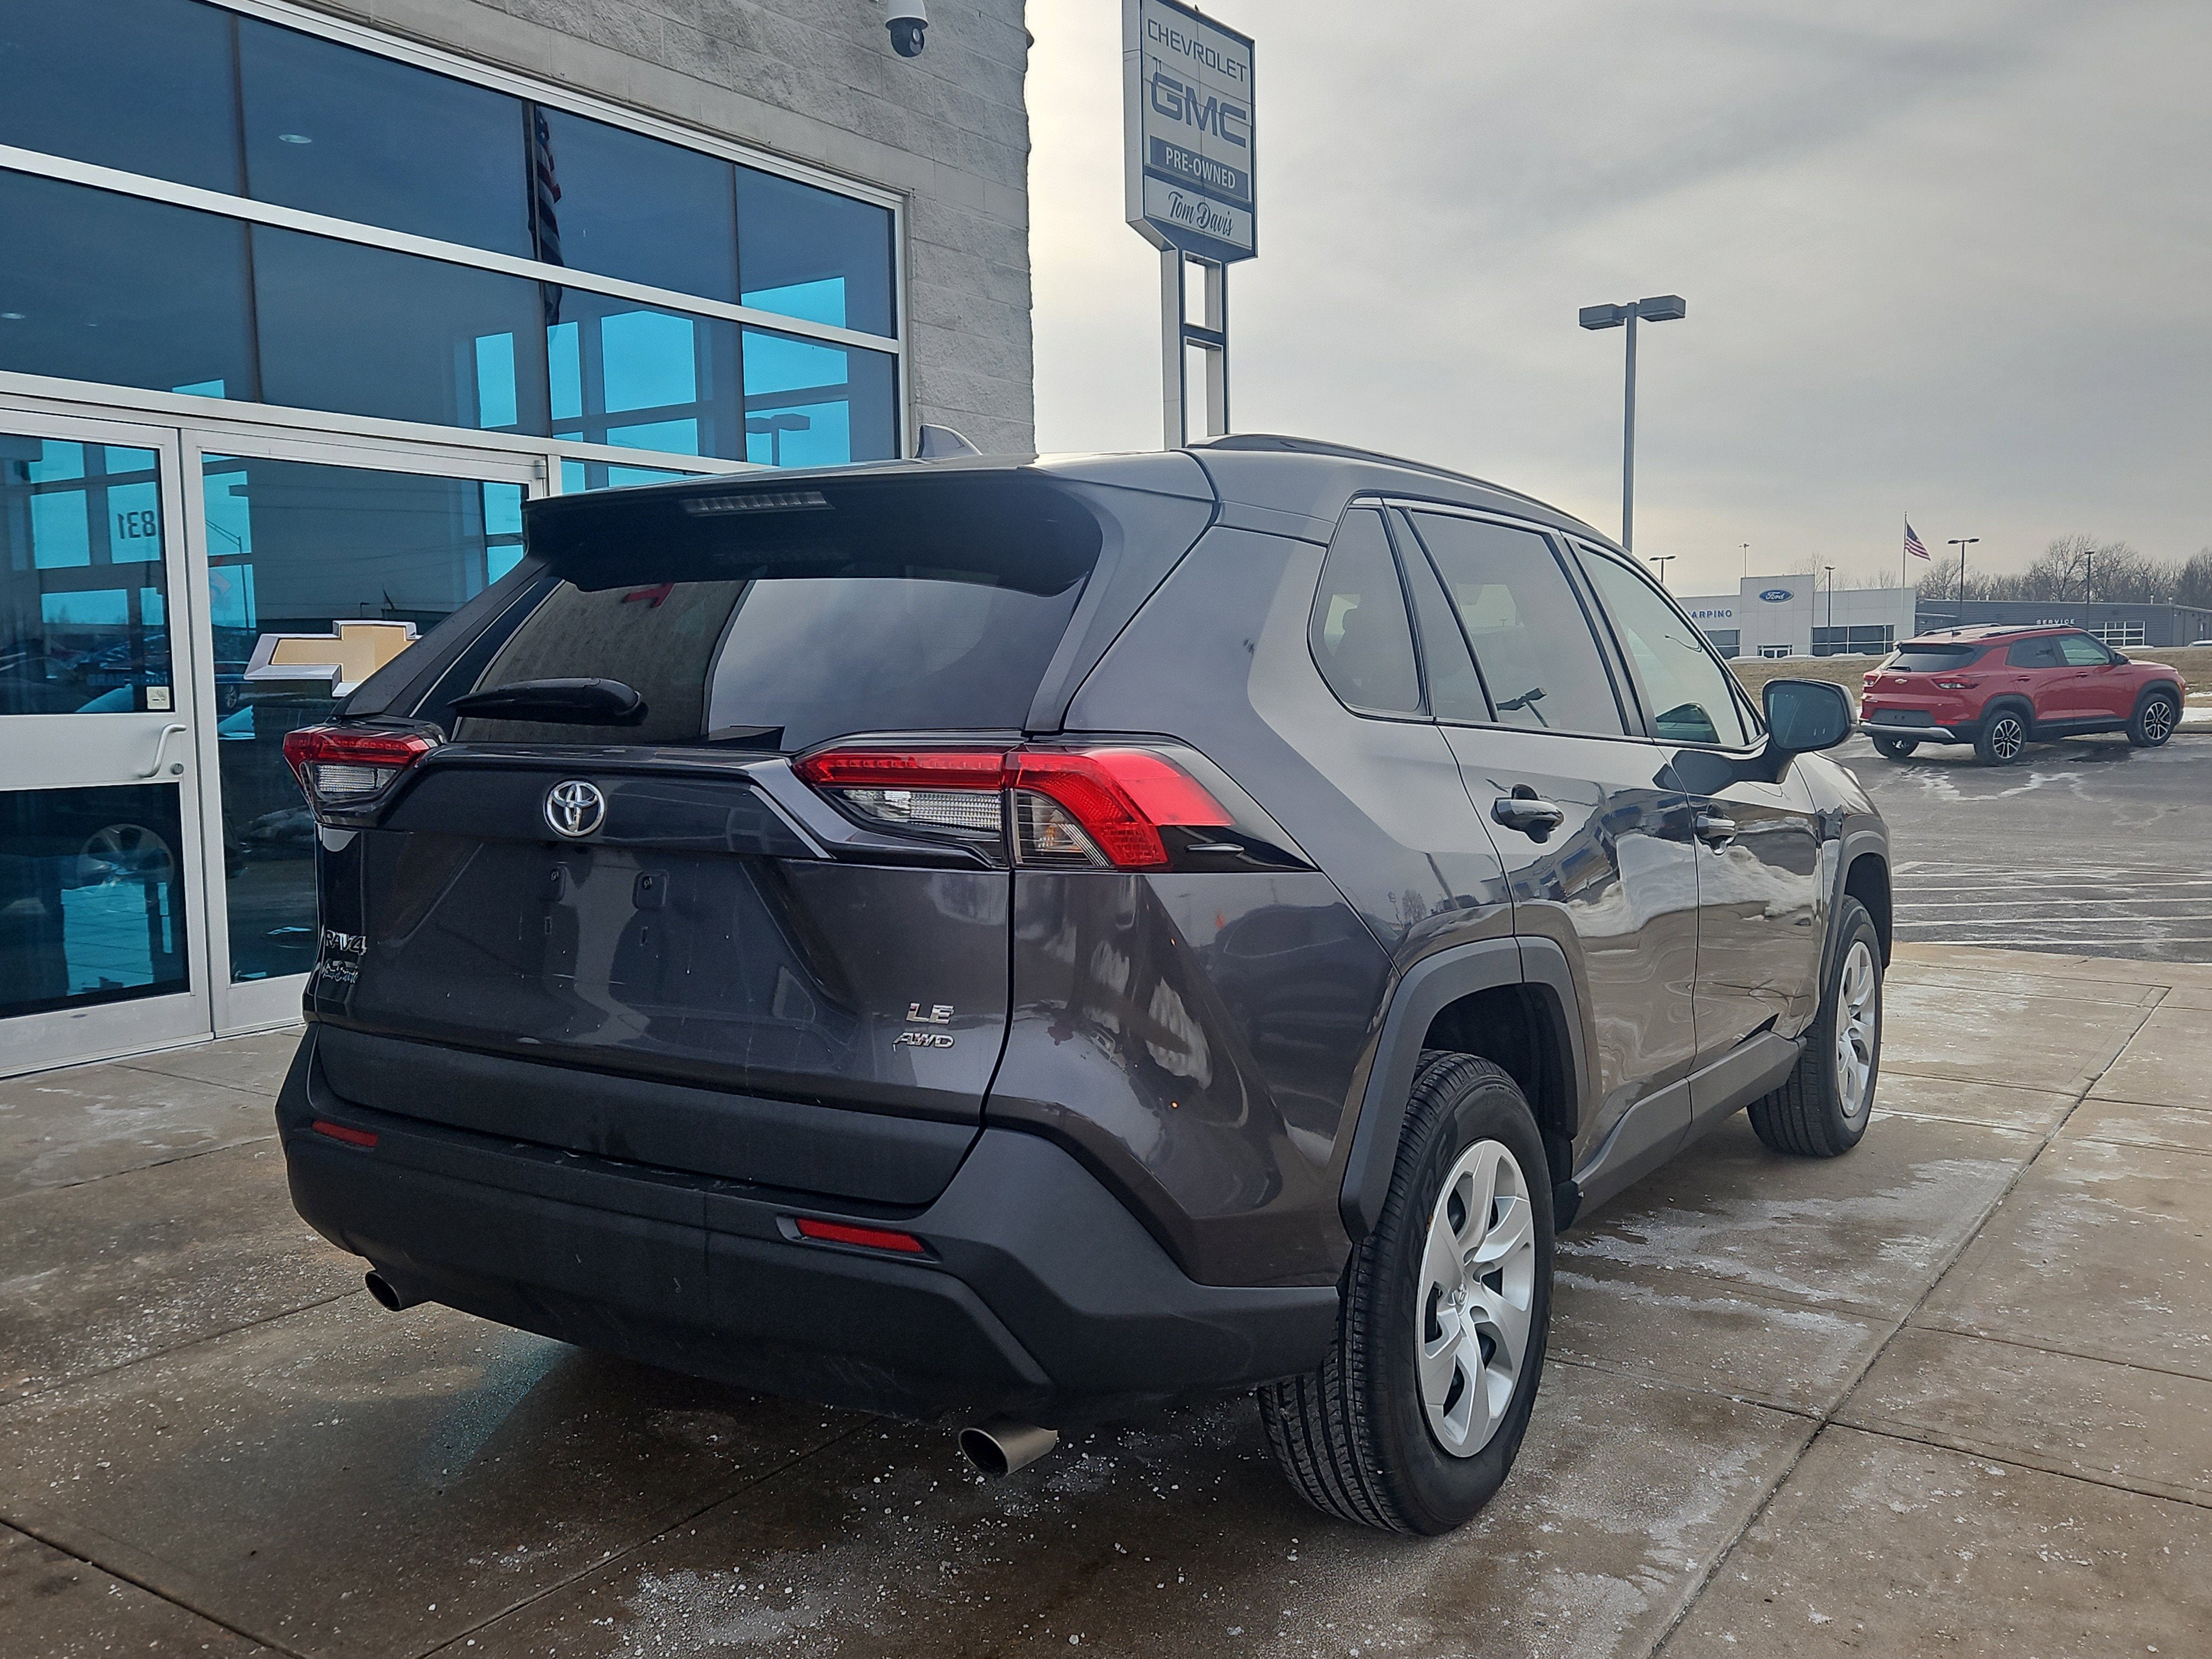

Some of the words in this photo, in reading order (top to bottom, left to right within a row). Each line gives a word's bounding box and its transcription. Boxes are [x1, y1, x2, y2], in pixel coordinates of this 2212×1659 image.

[1147, 18, 1246, 82] CHEVROLET
[1151, 71, 1246, 149] GMC
[1166, 146, 1236, 189] PRE-OWNED
[1168, 191, 1194, 224] Tom
[1197, 202, 1234, 236] Davis
[1765, 591, 1785, 600] Ford
[1688, 610, 1732, 618] ARPINO
[326, 929, 368, 956] RAV4
[906, 1002, 954, 1024] LE
[892, 1032, 954, 1052] AWD
